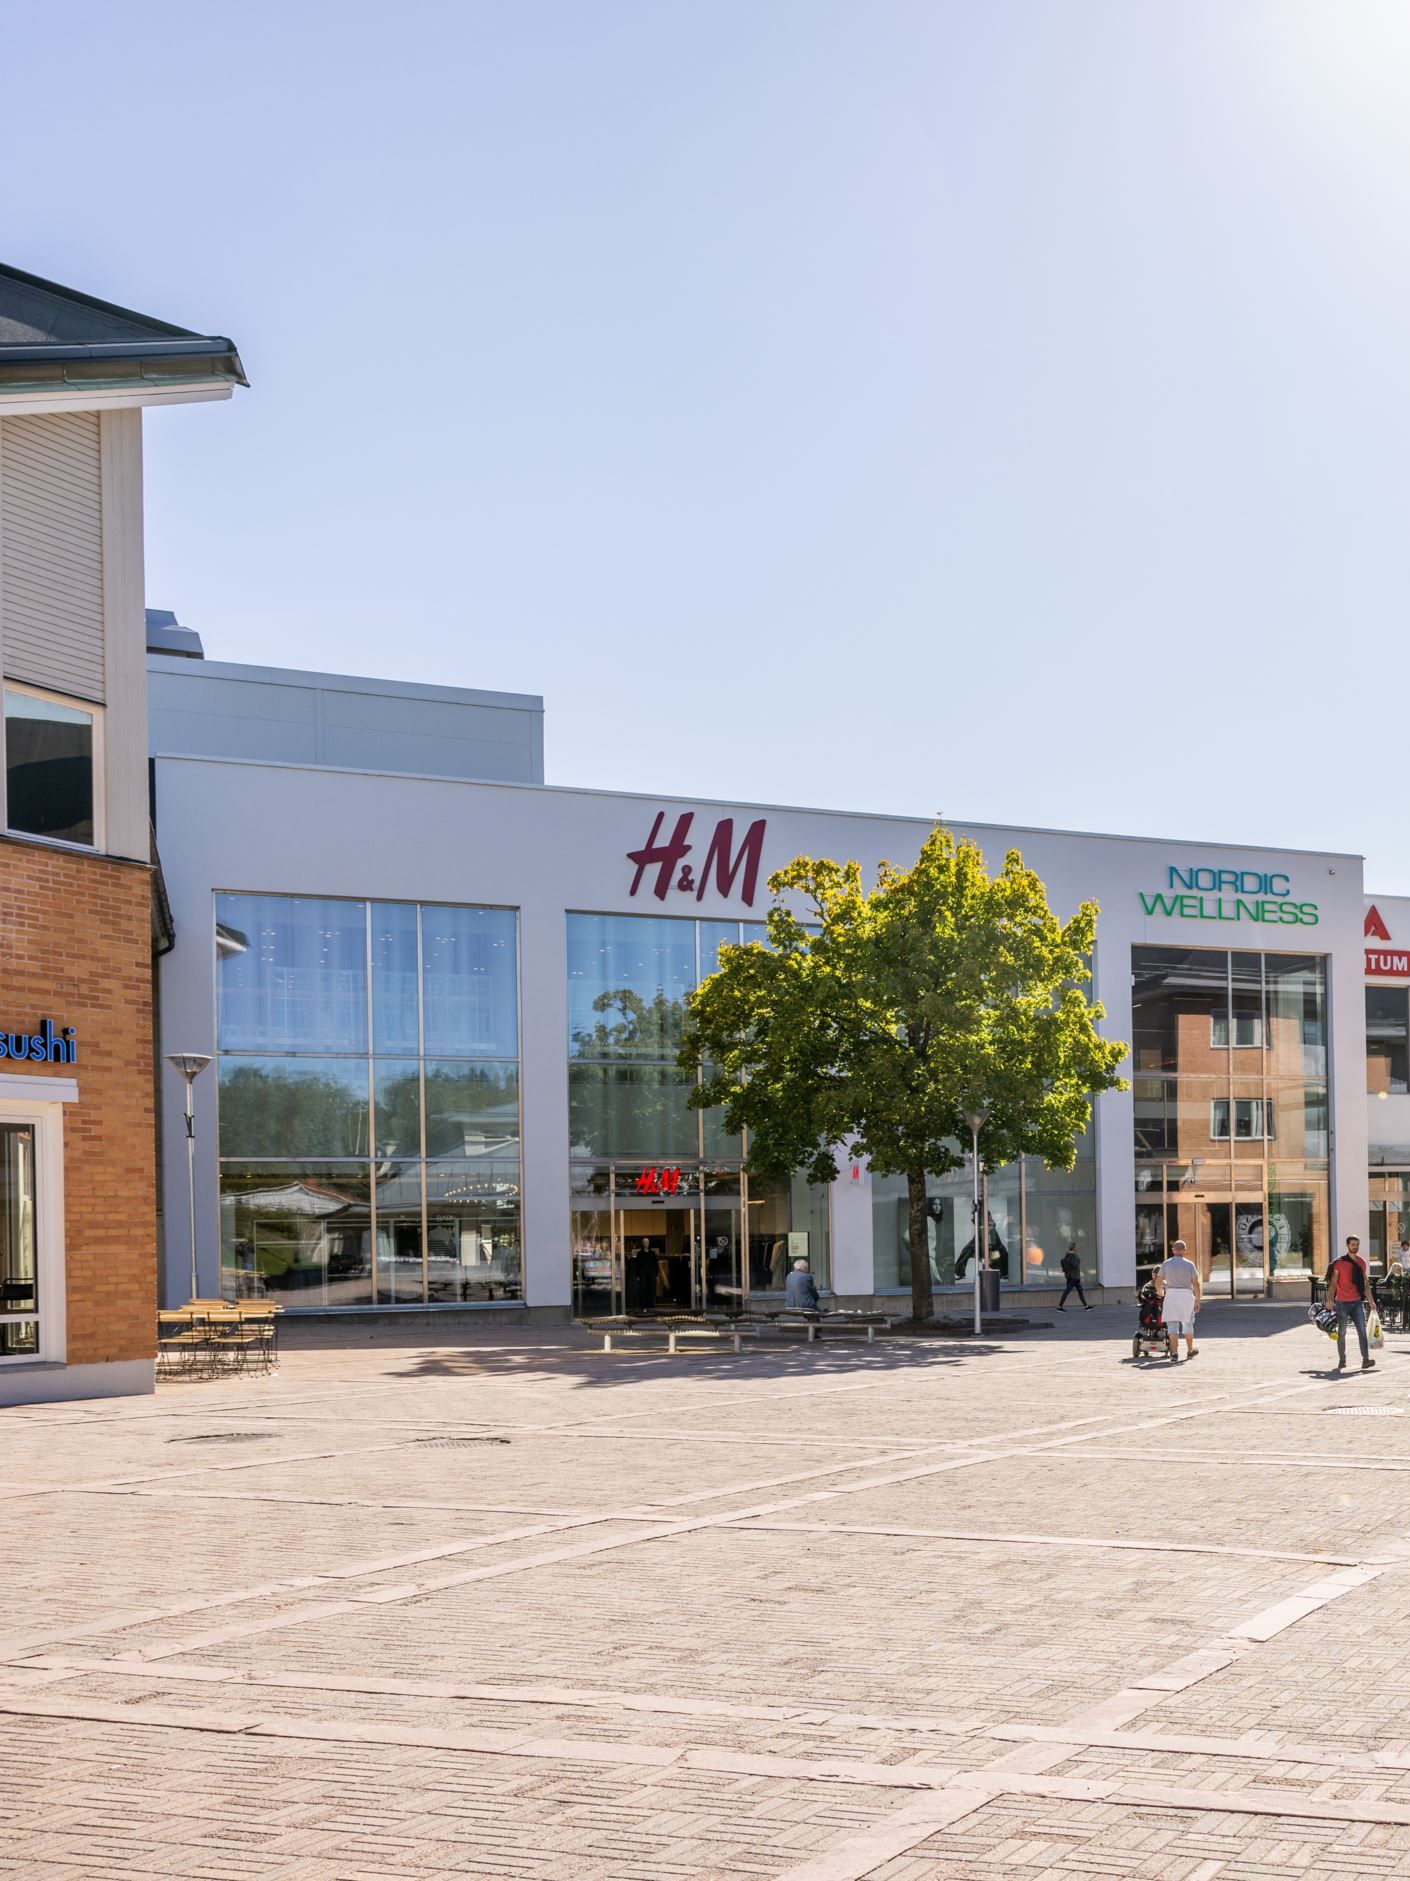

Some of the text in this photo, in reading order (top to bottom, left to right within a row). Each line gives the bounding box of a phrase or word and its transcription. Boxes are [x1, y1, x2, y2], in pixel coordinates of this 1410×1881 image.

[627, 811, 766, 907] H&M
[1168, 865, 1290, 897] NORDIC
[1139, 892, 1319, 925] WELLNESS
[1365, 954, 1408, 971] TUM
